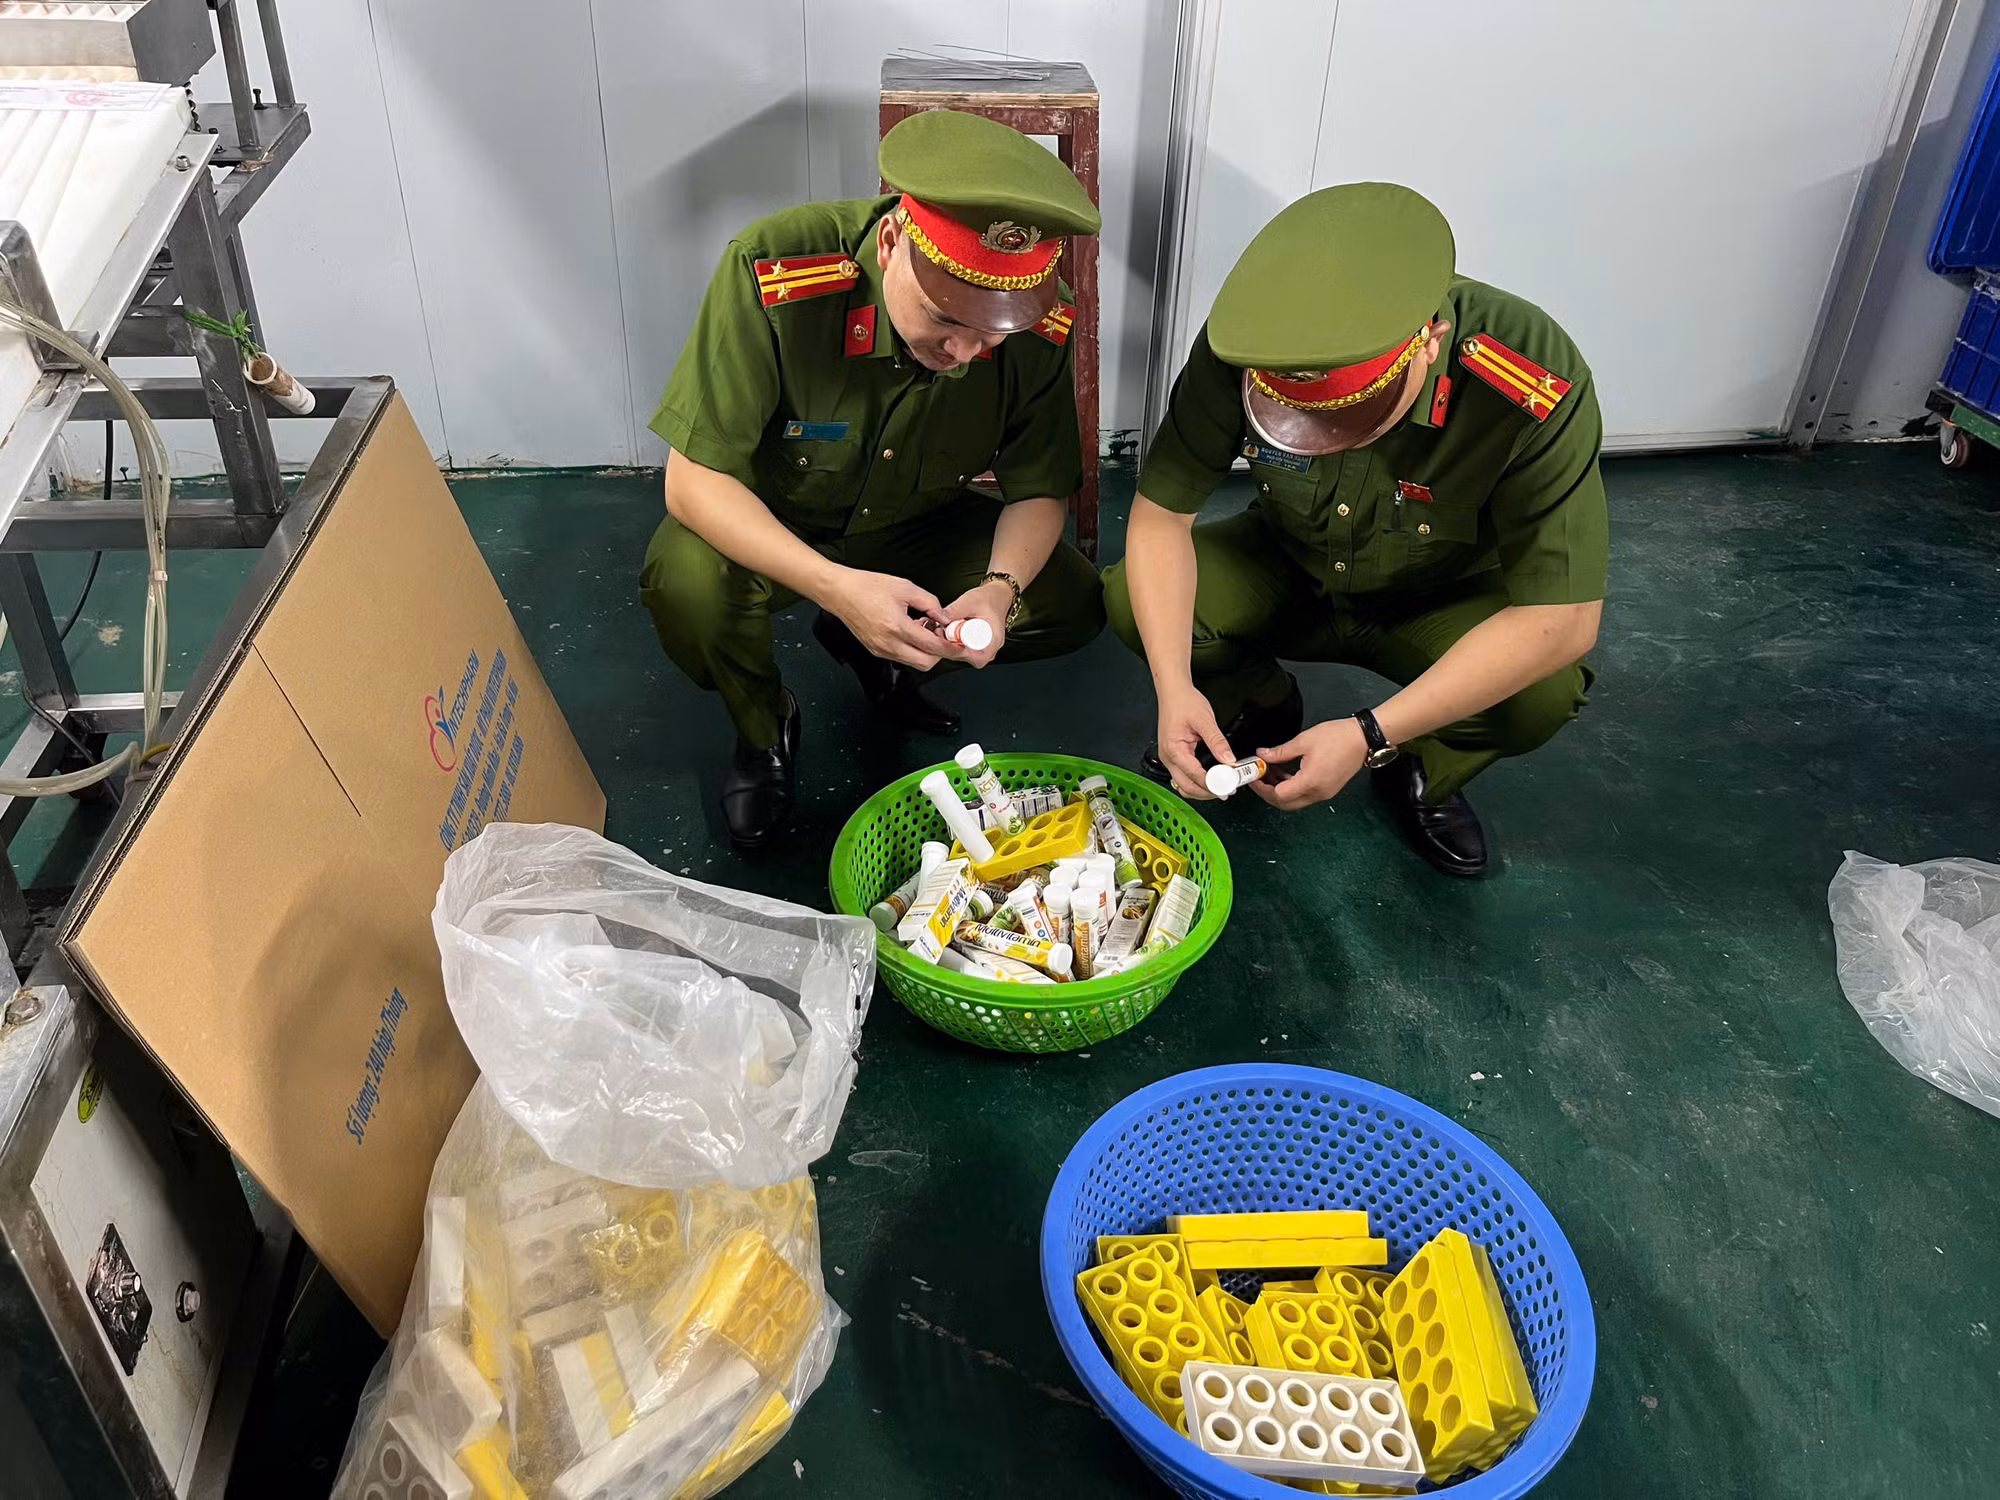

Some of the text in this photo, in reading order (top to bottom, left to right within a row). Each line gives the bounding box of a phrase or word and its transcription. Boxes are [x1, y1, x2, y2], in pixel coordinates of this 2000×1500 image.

[975, 923, 1041, 948] Multivitamin
[1080, 930, 1090, 978] ultivitamin
[366, 1047, 385, 1085] 240
[351, 1075, 380, 1126] lượng:
[346, 1107, 365, 1145] Số
